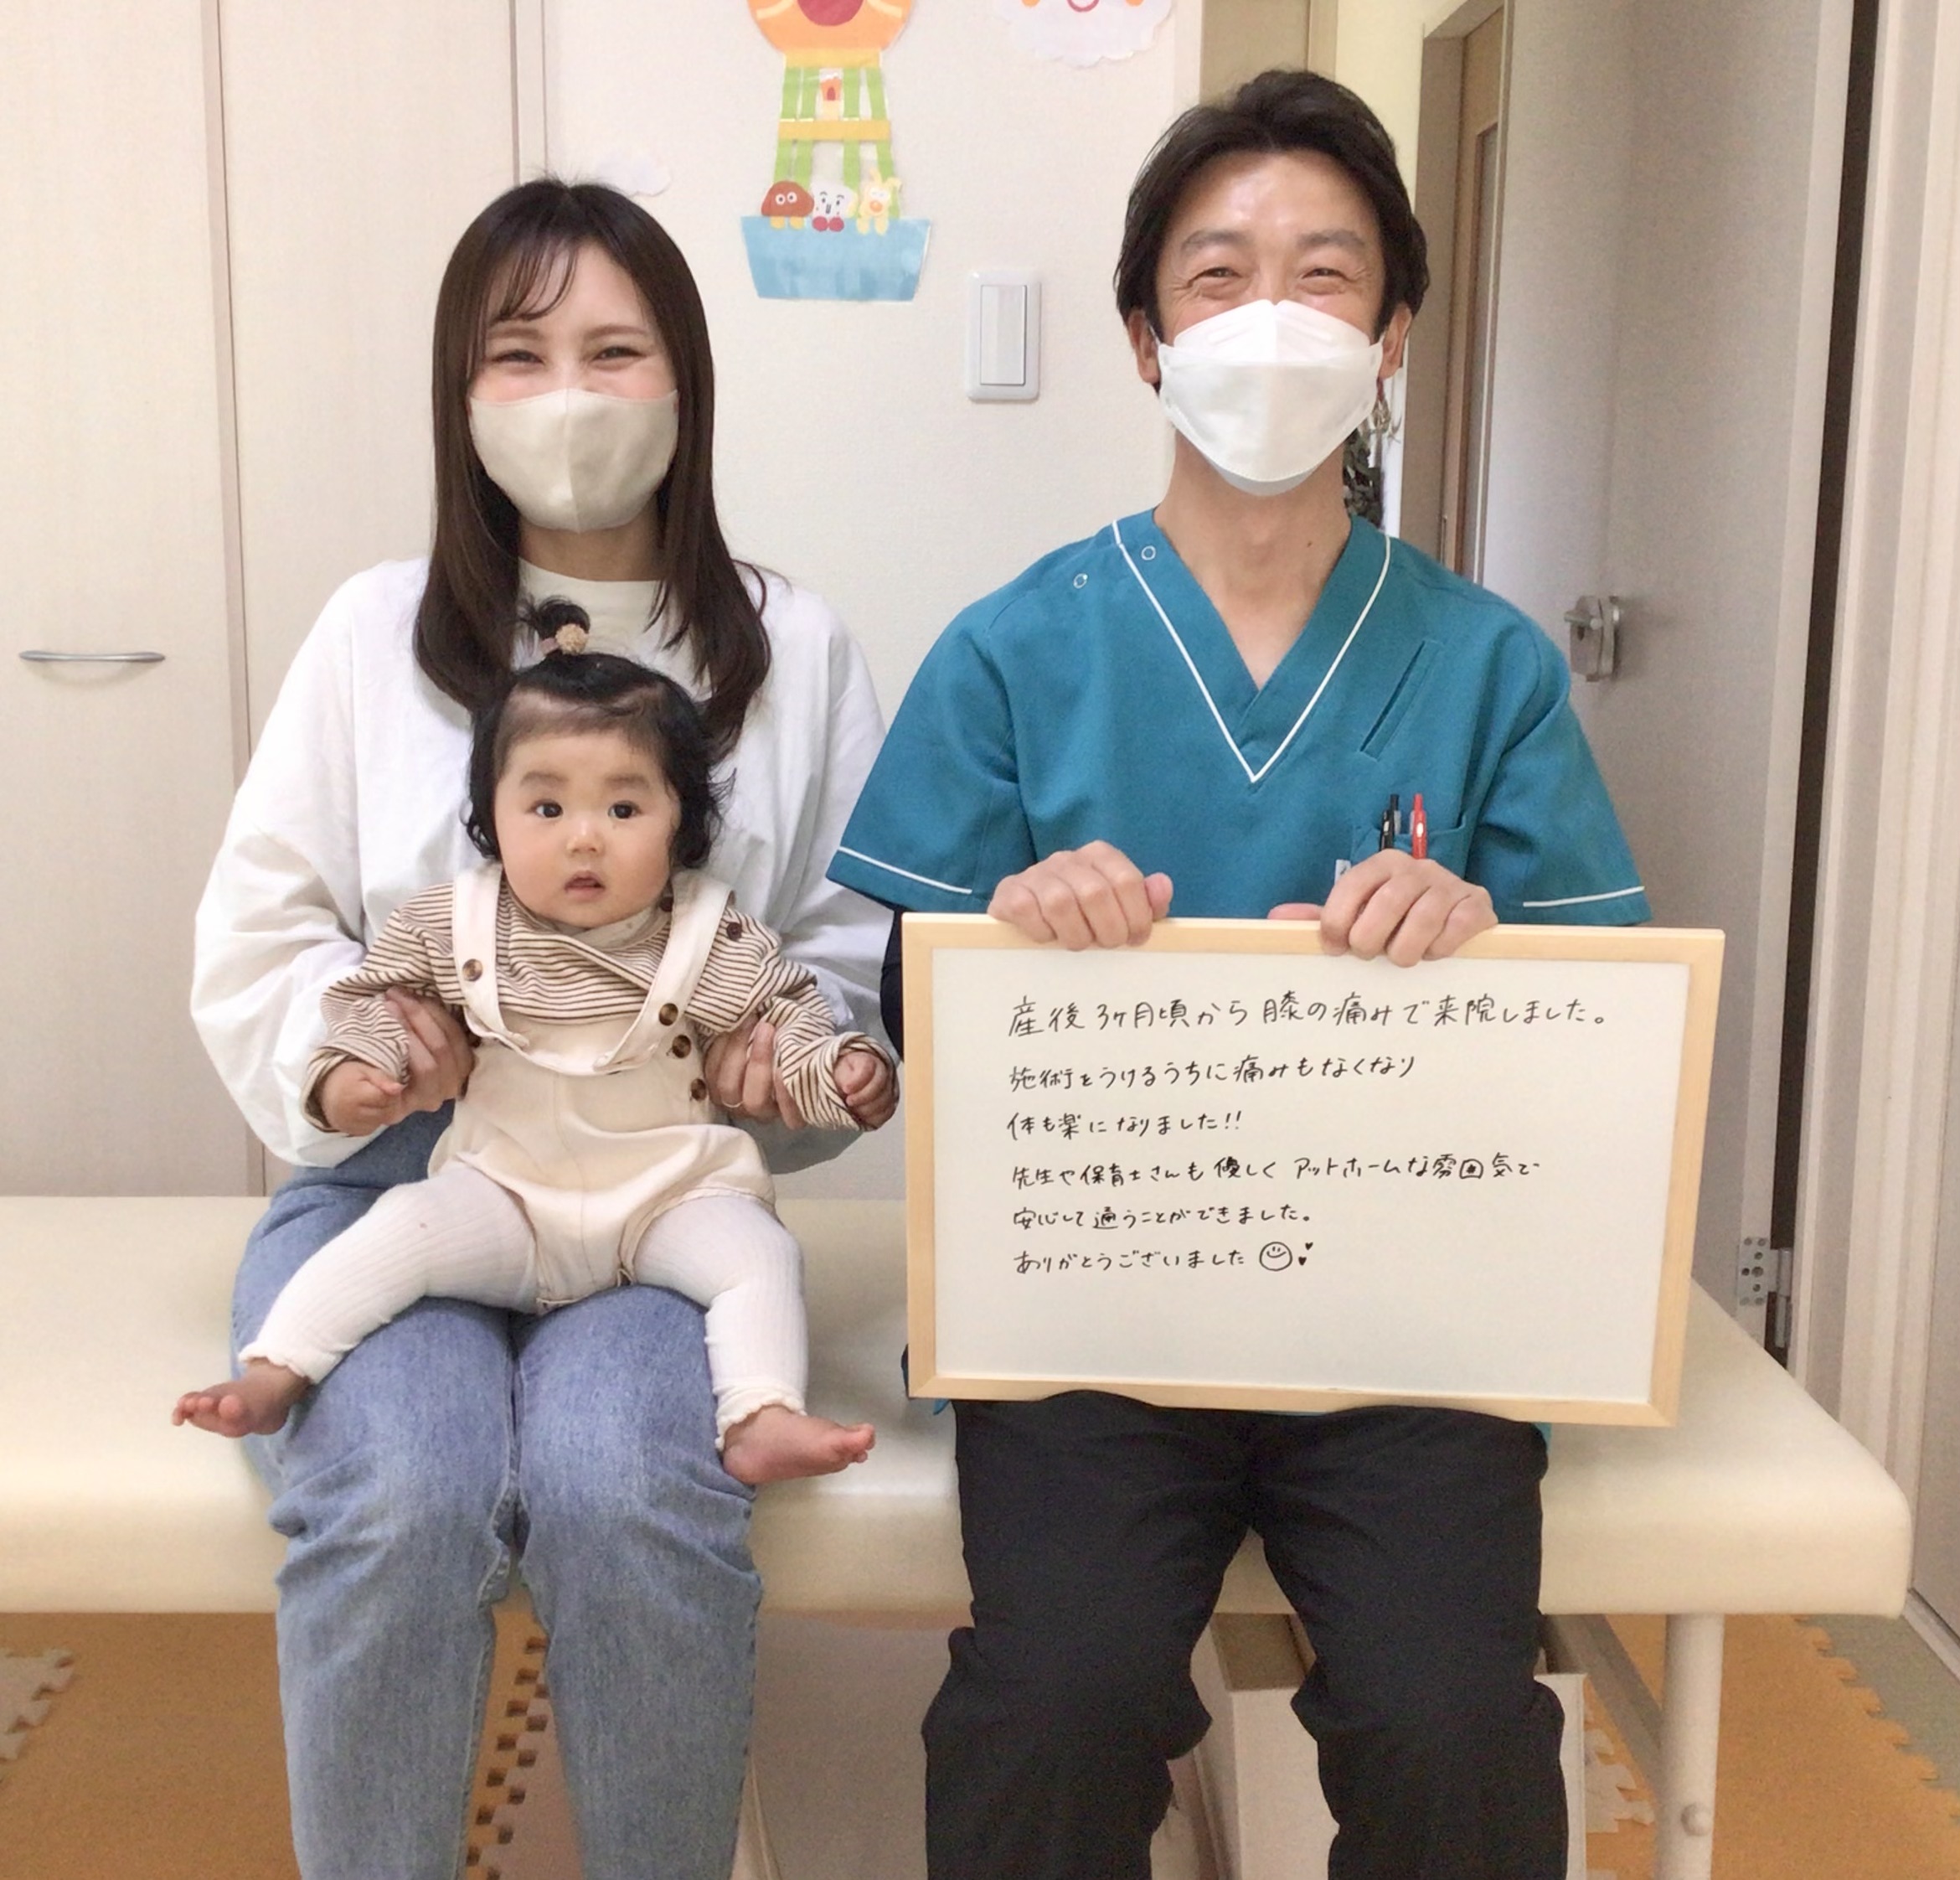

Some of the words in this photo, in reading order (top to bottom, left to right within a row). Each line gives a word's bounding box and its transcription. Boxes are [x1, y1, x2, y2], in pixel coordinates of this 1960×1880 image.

[1008, 1054, 1415, 1092] 施術をうけるうちに痛みもなくなり
[1013, 1249, 1245, 1274] ありがとうございました
